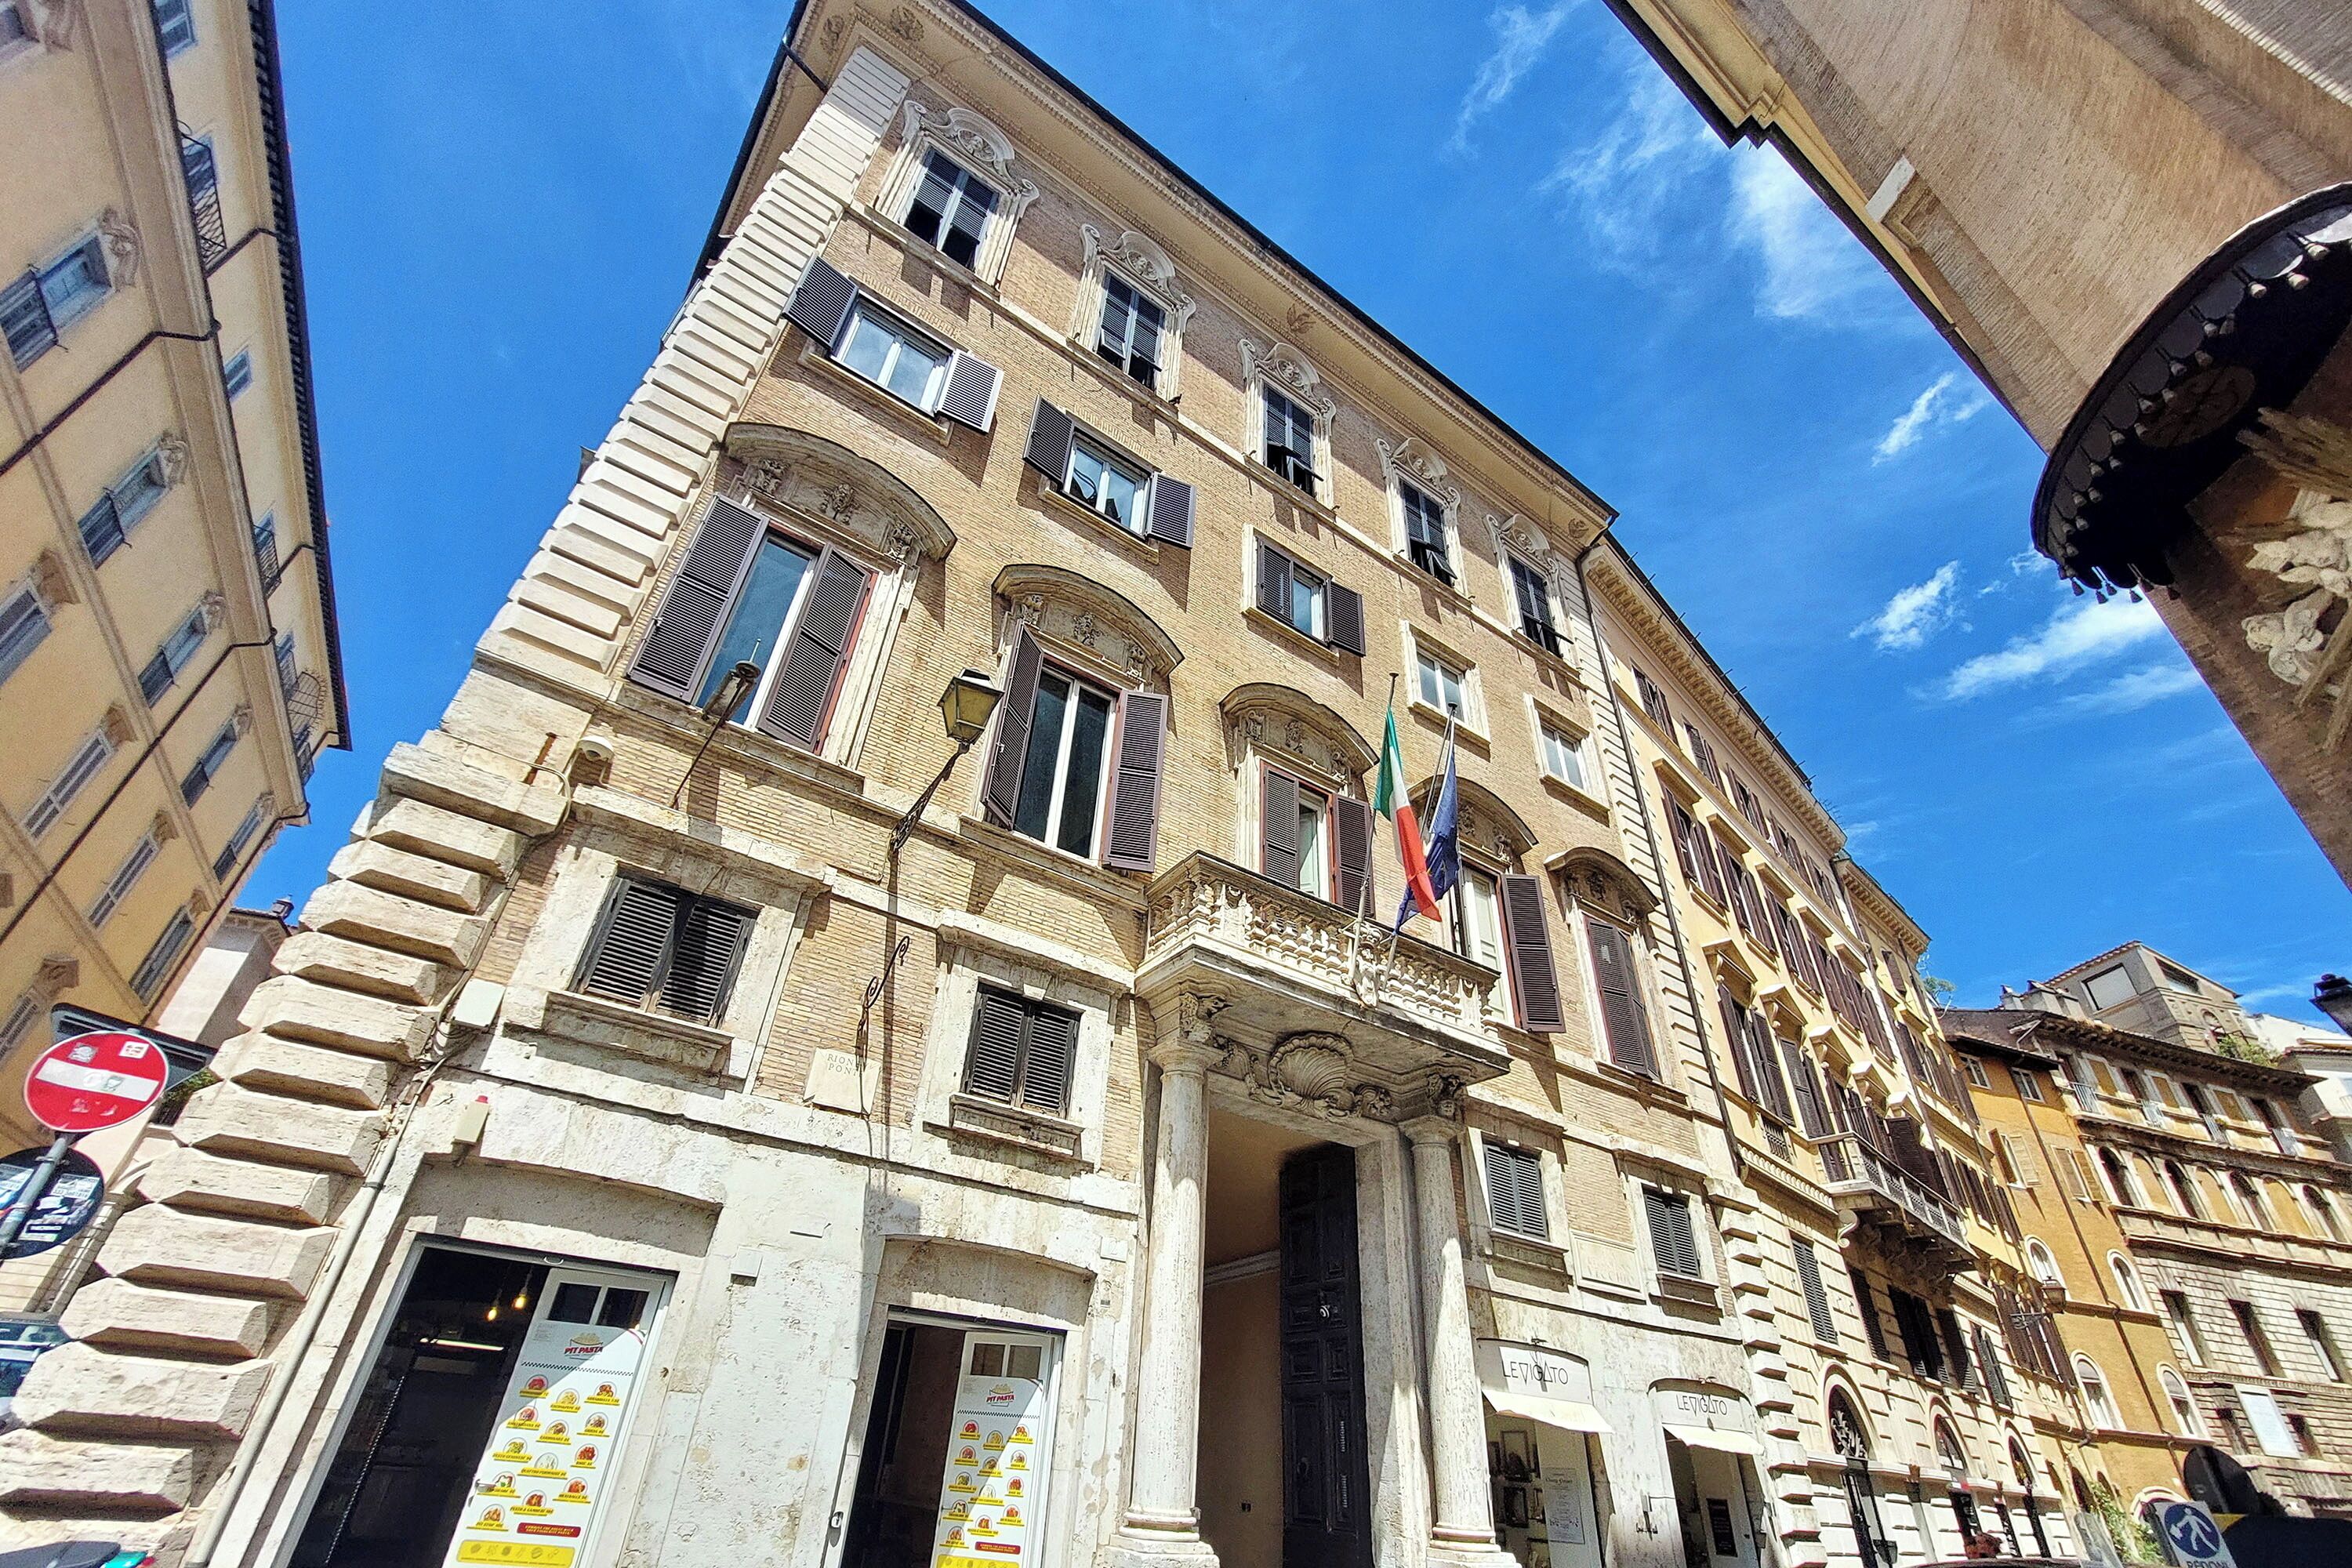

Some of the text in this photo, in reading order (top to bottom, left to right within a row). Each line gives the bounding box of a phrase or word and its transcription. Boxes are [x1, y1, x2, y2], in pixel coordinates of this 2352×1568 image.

[827, 1054, 855, 1067] RION
[828, 1063, 857, 1076] PONT
[1502, 1360, 1568, 1385] LEVIGATO
[1676, 1394, 1727, 1416] LEVIGATO
